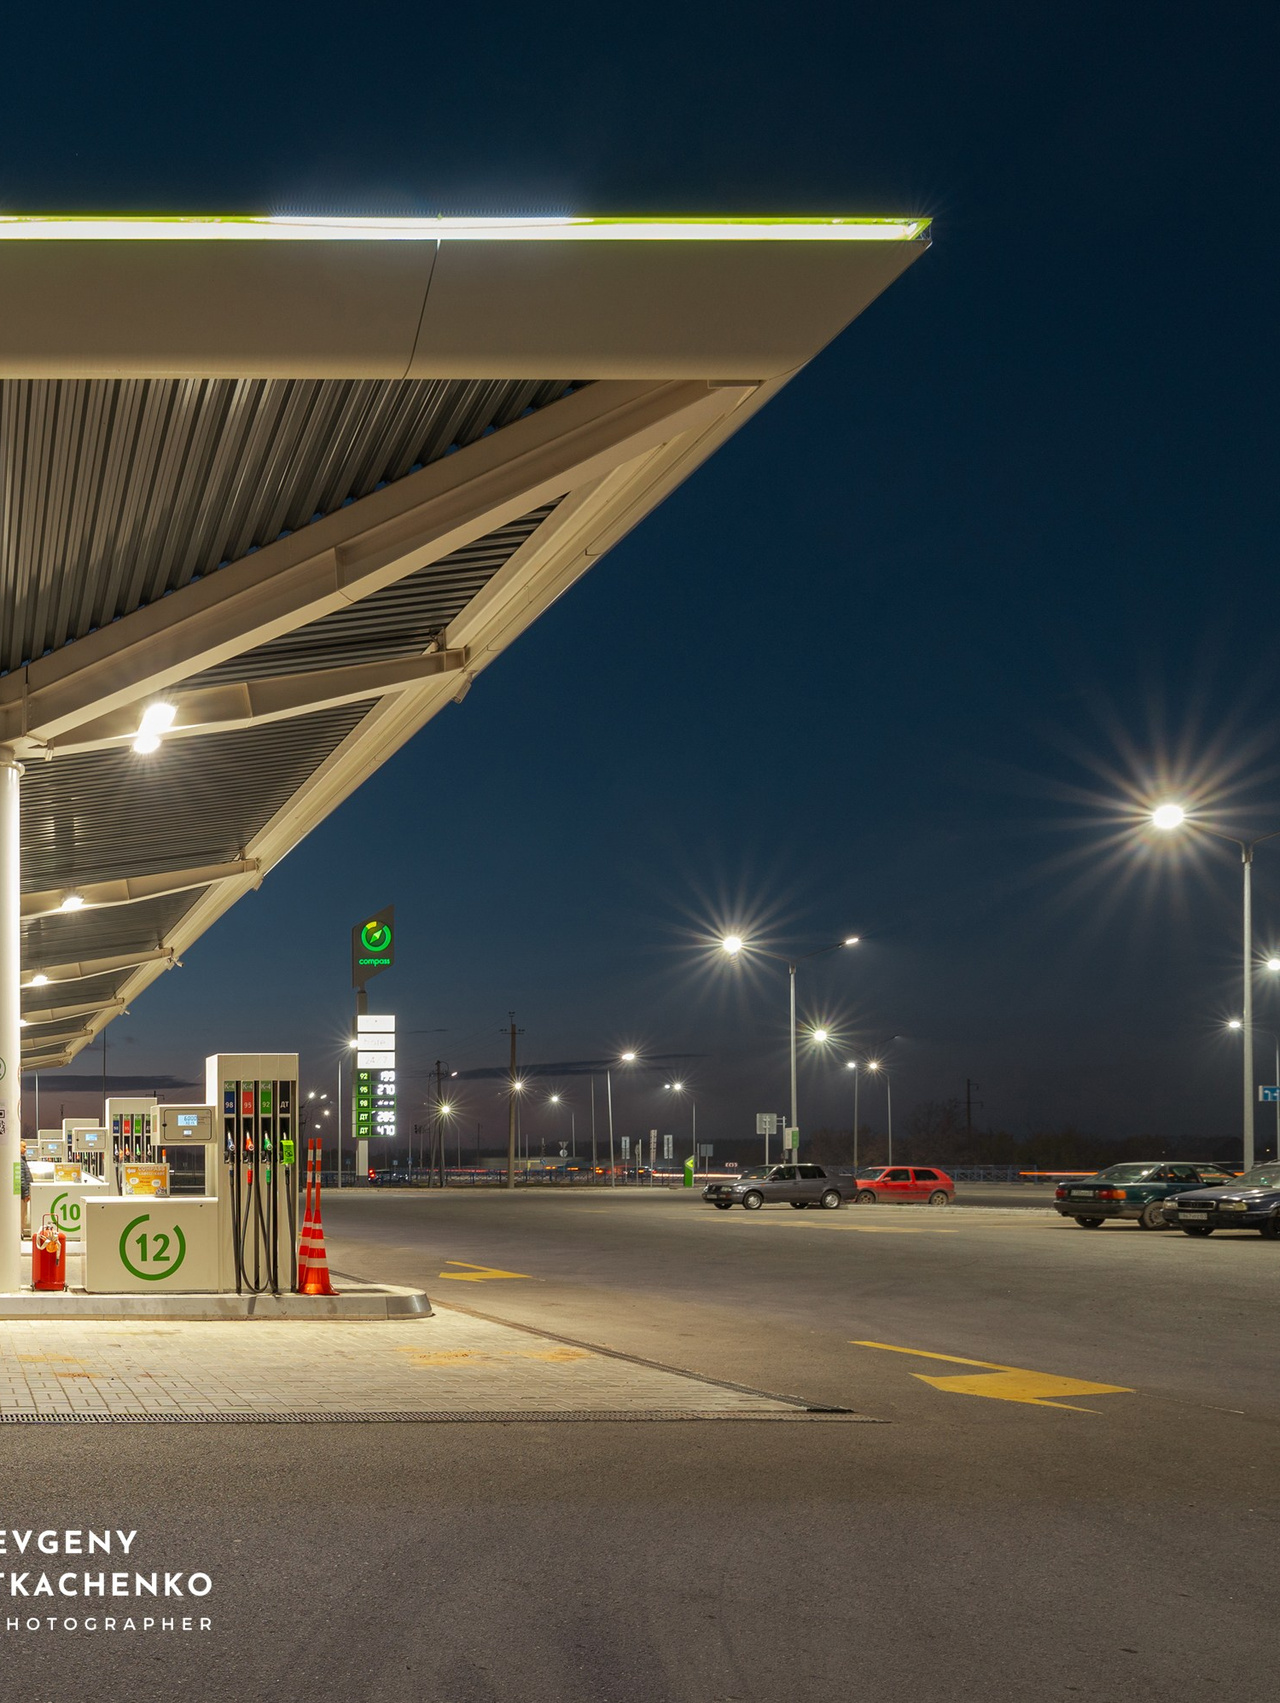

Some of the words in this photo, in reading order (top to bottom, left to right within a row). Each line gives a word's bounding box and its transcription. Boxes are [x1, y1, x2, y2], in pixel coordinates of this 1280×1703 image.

[358, 958, 391, 967] compass
[377, 1084, 396, 1095] 270
[376, 1125, 396, 1136] 470
[59, 1203, 81, 1221] 10
[135, 1233, 170, 1262] 12
